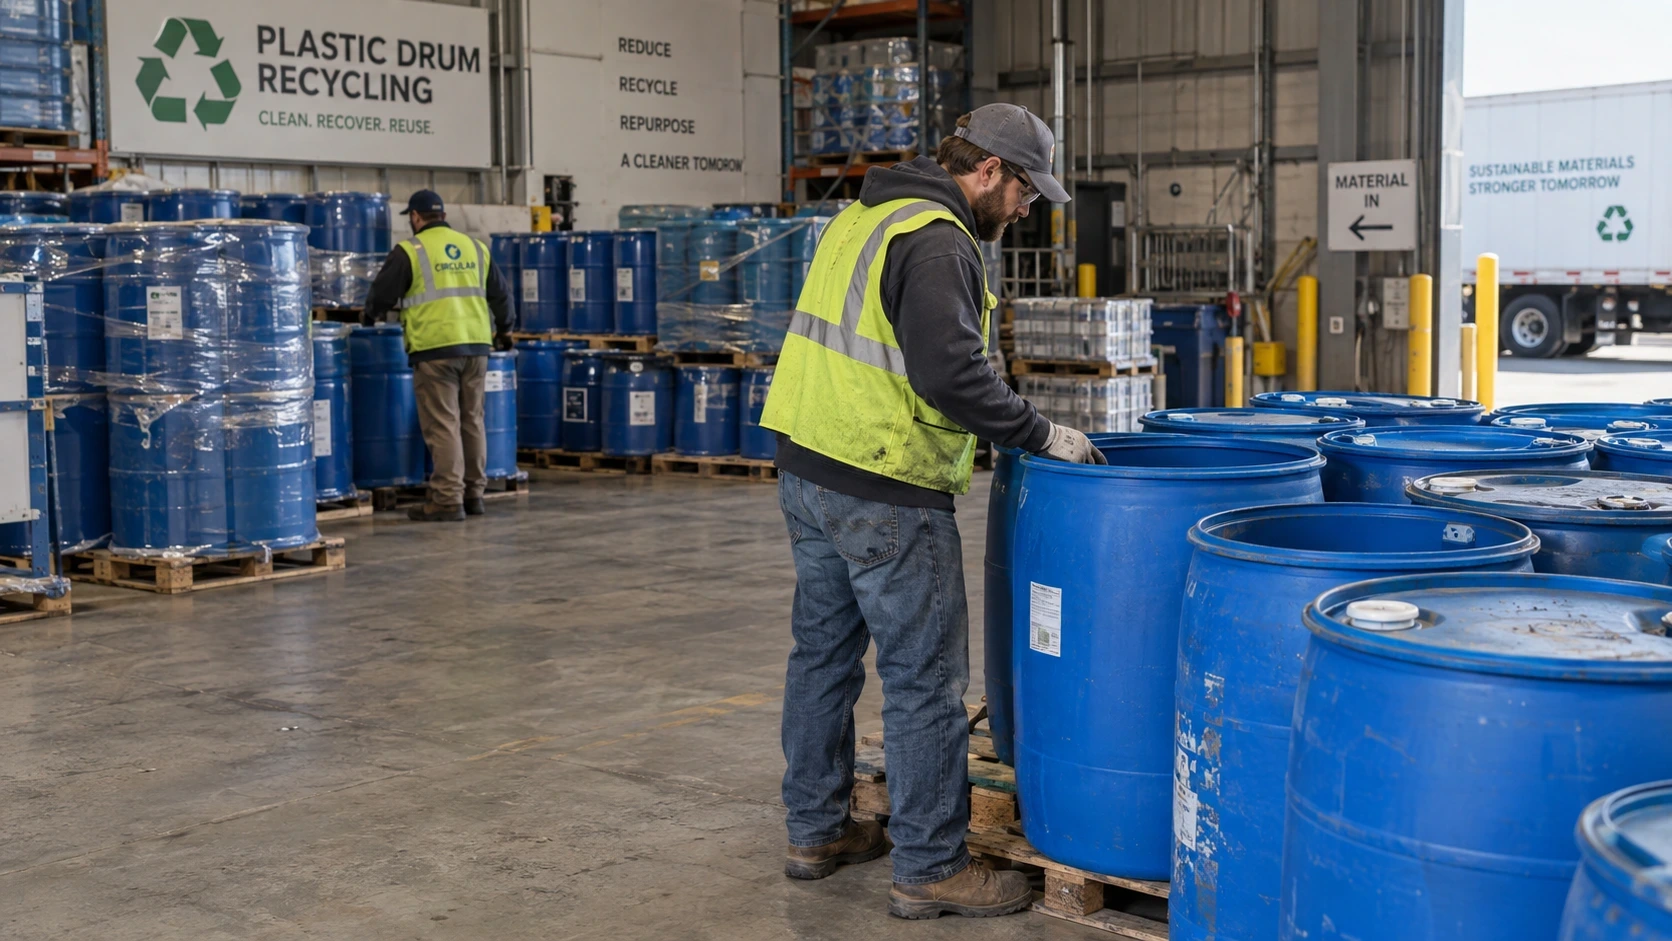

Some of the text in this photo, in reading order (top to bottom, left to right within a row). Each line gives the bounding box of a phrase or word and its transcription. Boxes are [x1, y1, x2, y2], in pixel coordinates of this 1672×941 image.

[257, 24, 481, 73] PLASTIC DRUM
[618, 37, 671, 58] REDUCE
[258, 62, 433, 104] RECYCLING
[619, 76, 678, 96] RECYCLE
[258, 110, 435, 135] CLEAN. RECOVER. REUSE.
[620, 114, 695, 135] REPURPOSE
[620, 153, 630, 168] A
[633, 153, 690, 170] CLEANER
[1469, 155, 1635, 178] SUSTAINABLE MATERIALS
[1336, 172, 1409, 189] MATERIAL
[1469, 174, 1621, 195] STRONGER TOMORROW
[1364, 194, 1379, 208] IN
[435, 261, 476, 273] CIRCULAR
